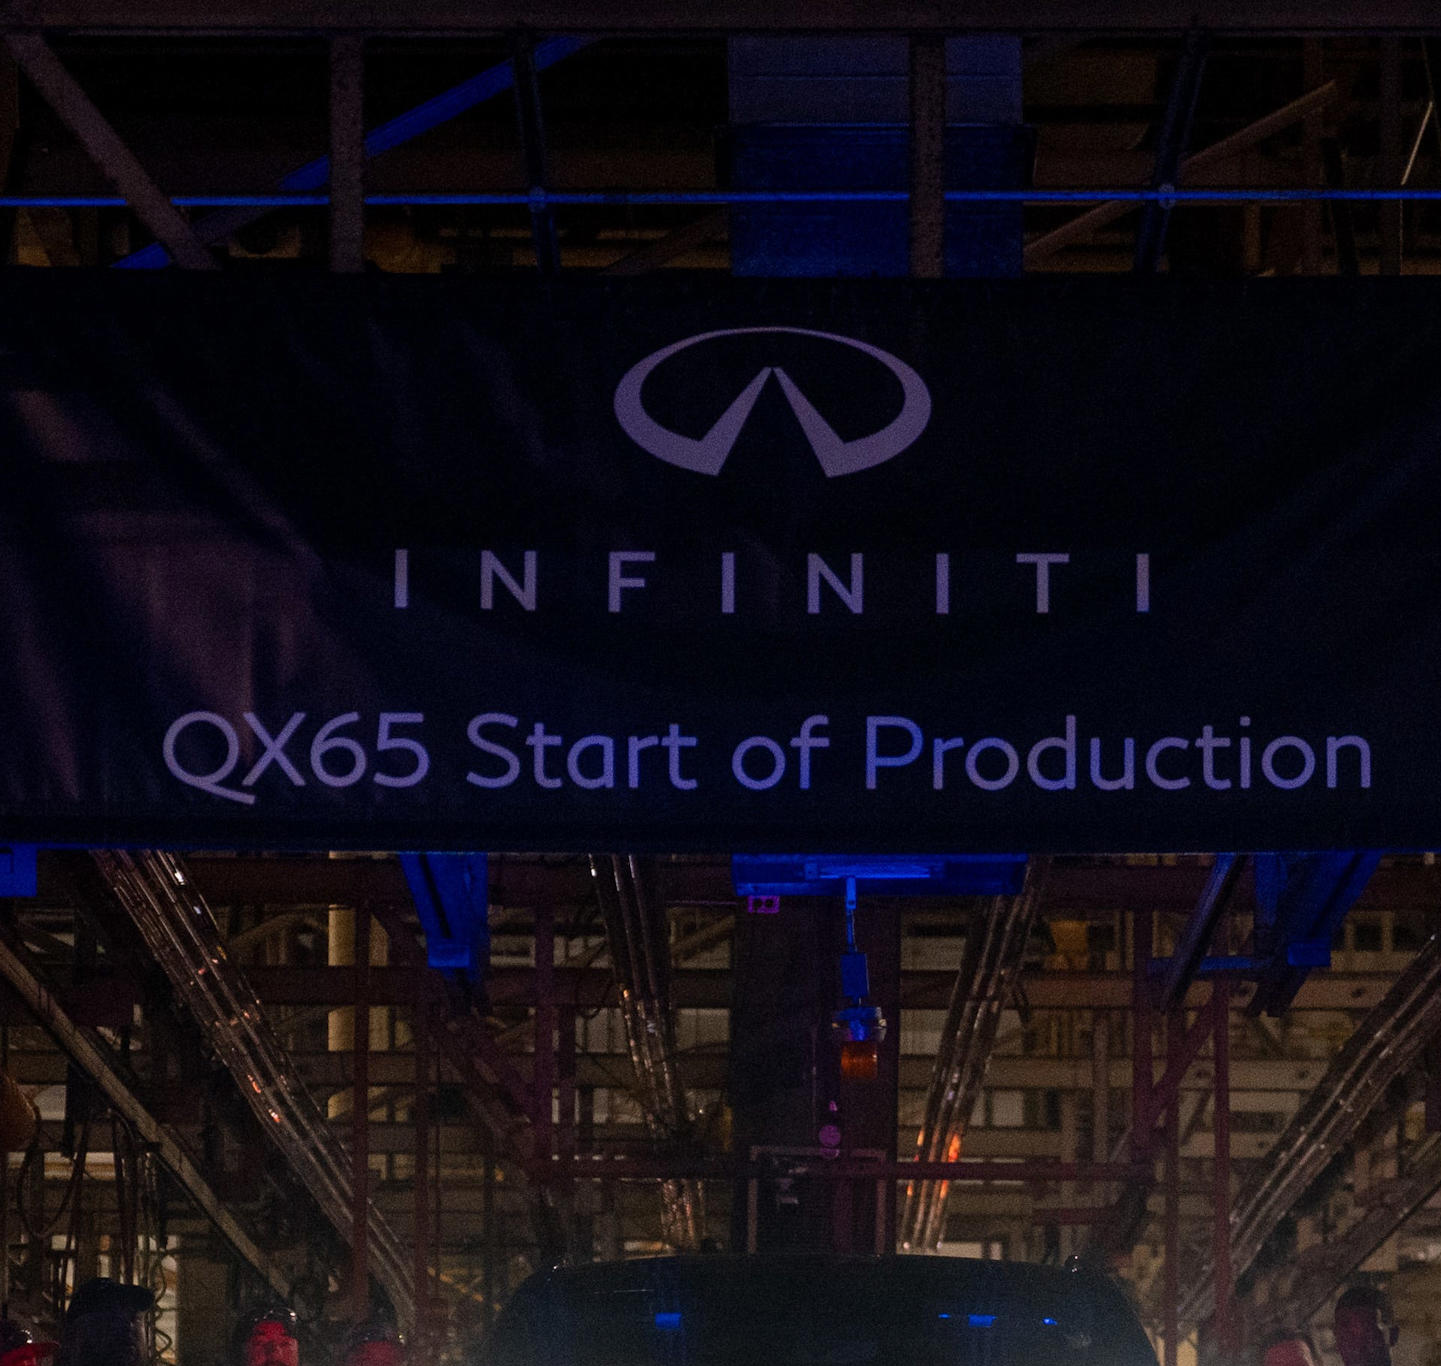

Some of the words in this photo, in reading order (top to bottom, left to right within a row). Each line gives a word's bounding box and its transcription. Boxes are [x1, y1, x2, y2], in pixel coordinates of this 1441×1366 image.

[394, 549, 1152, 615] INFINITI
[164, 711, 430, 804] QX65
[467, 712, 698, 791] Start
[731, 714, 830, 791] of
[865, 715, 1372, 791] Production
